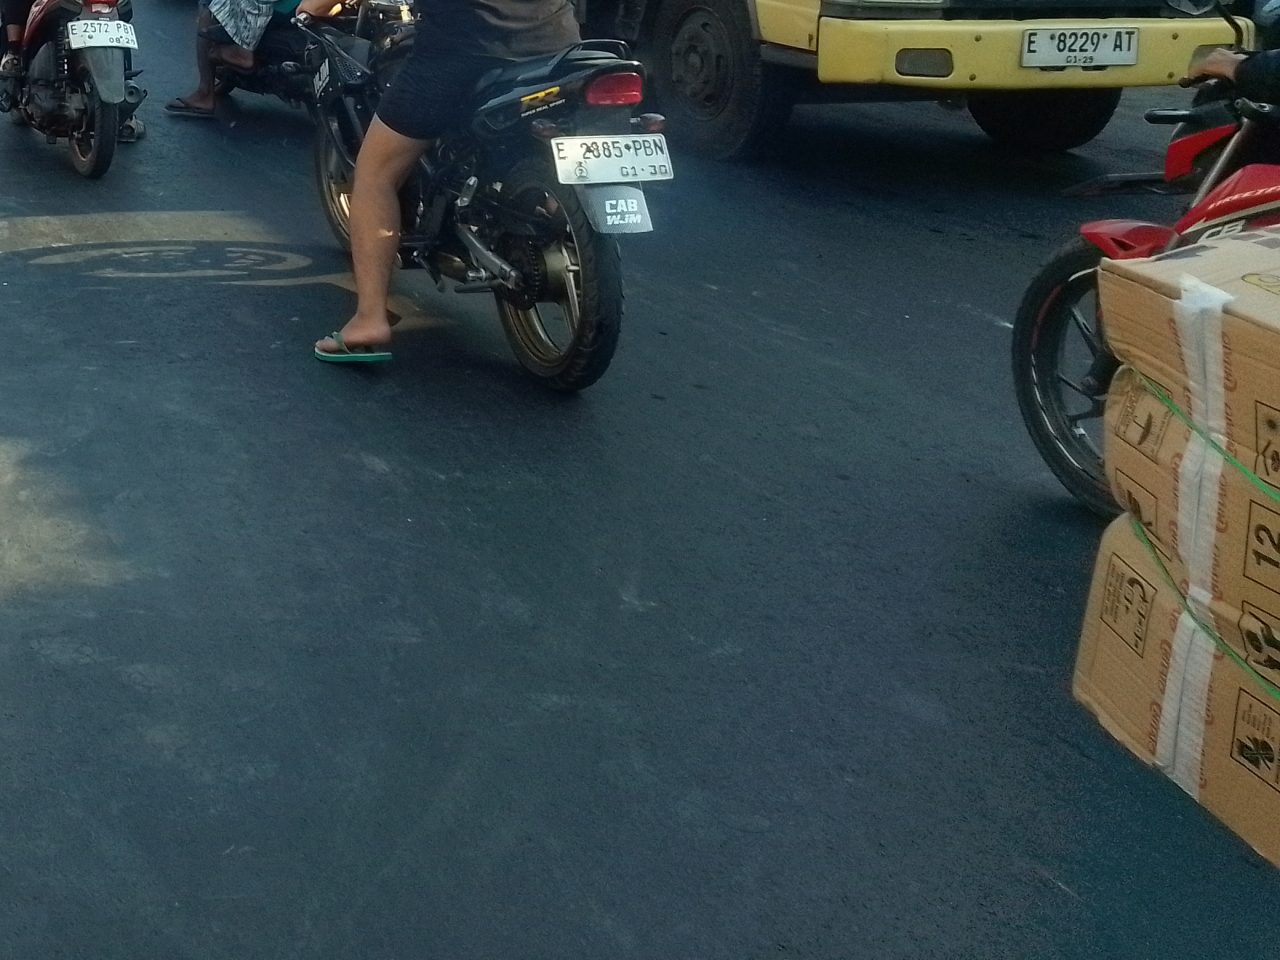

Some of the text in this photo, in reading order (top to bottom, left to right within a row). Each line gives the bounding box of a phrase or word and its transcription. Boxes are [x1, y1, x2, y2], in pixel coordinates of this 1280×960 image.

[70, 23, 78, 36] E
[82, 22, 110, 34] 2572
[1026, 29, 1136, 54] E 8229 AT
[556, 138, 666, 161] E 2885 PBN
[604, 199, 639, 214] CAB
[1198, 220, 1247, 242] CB
